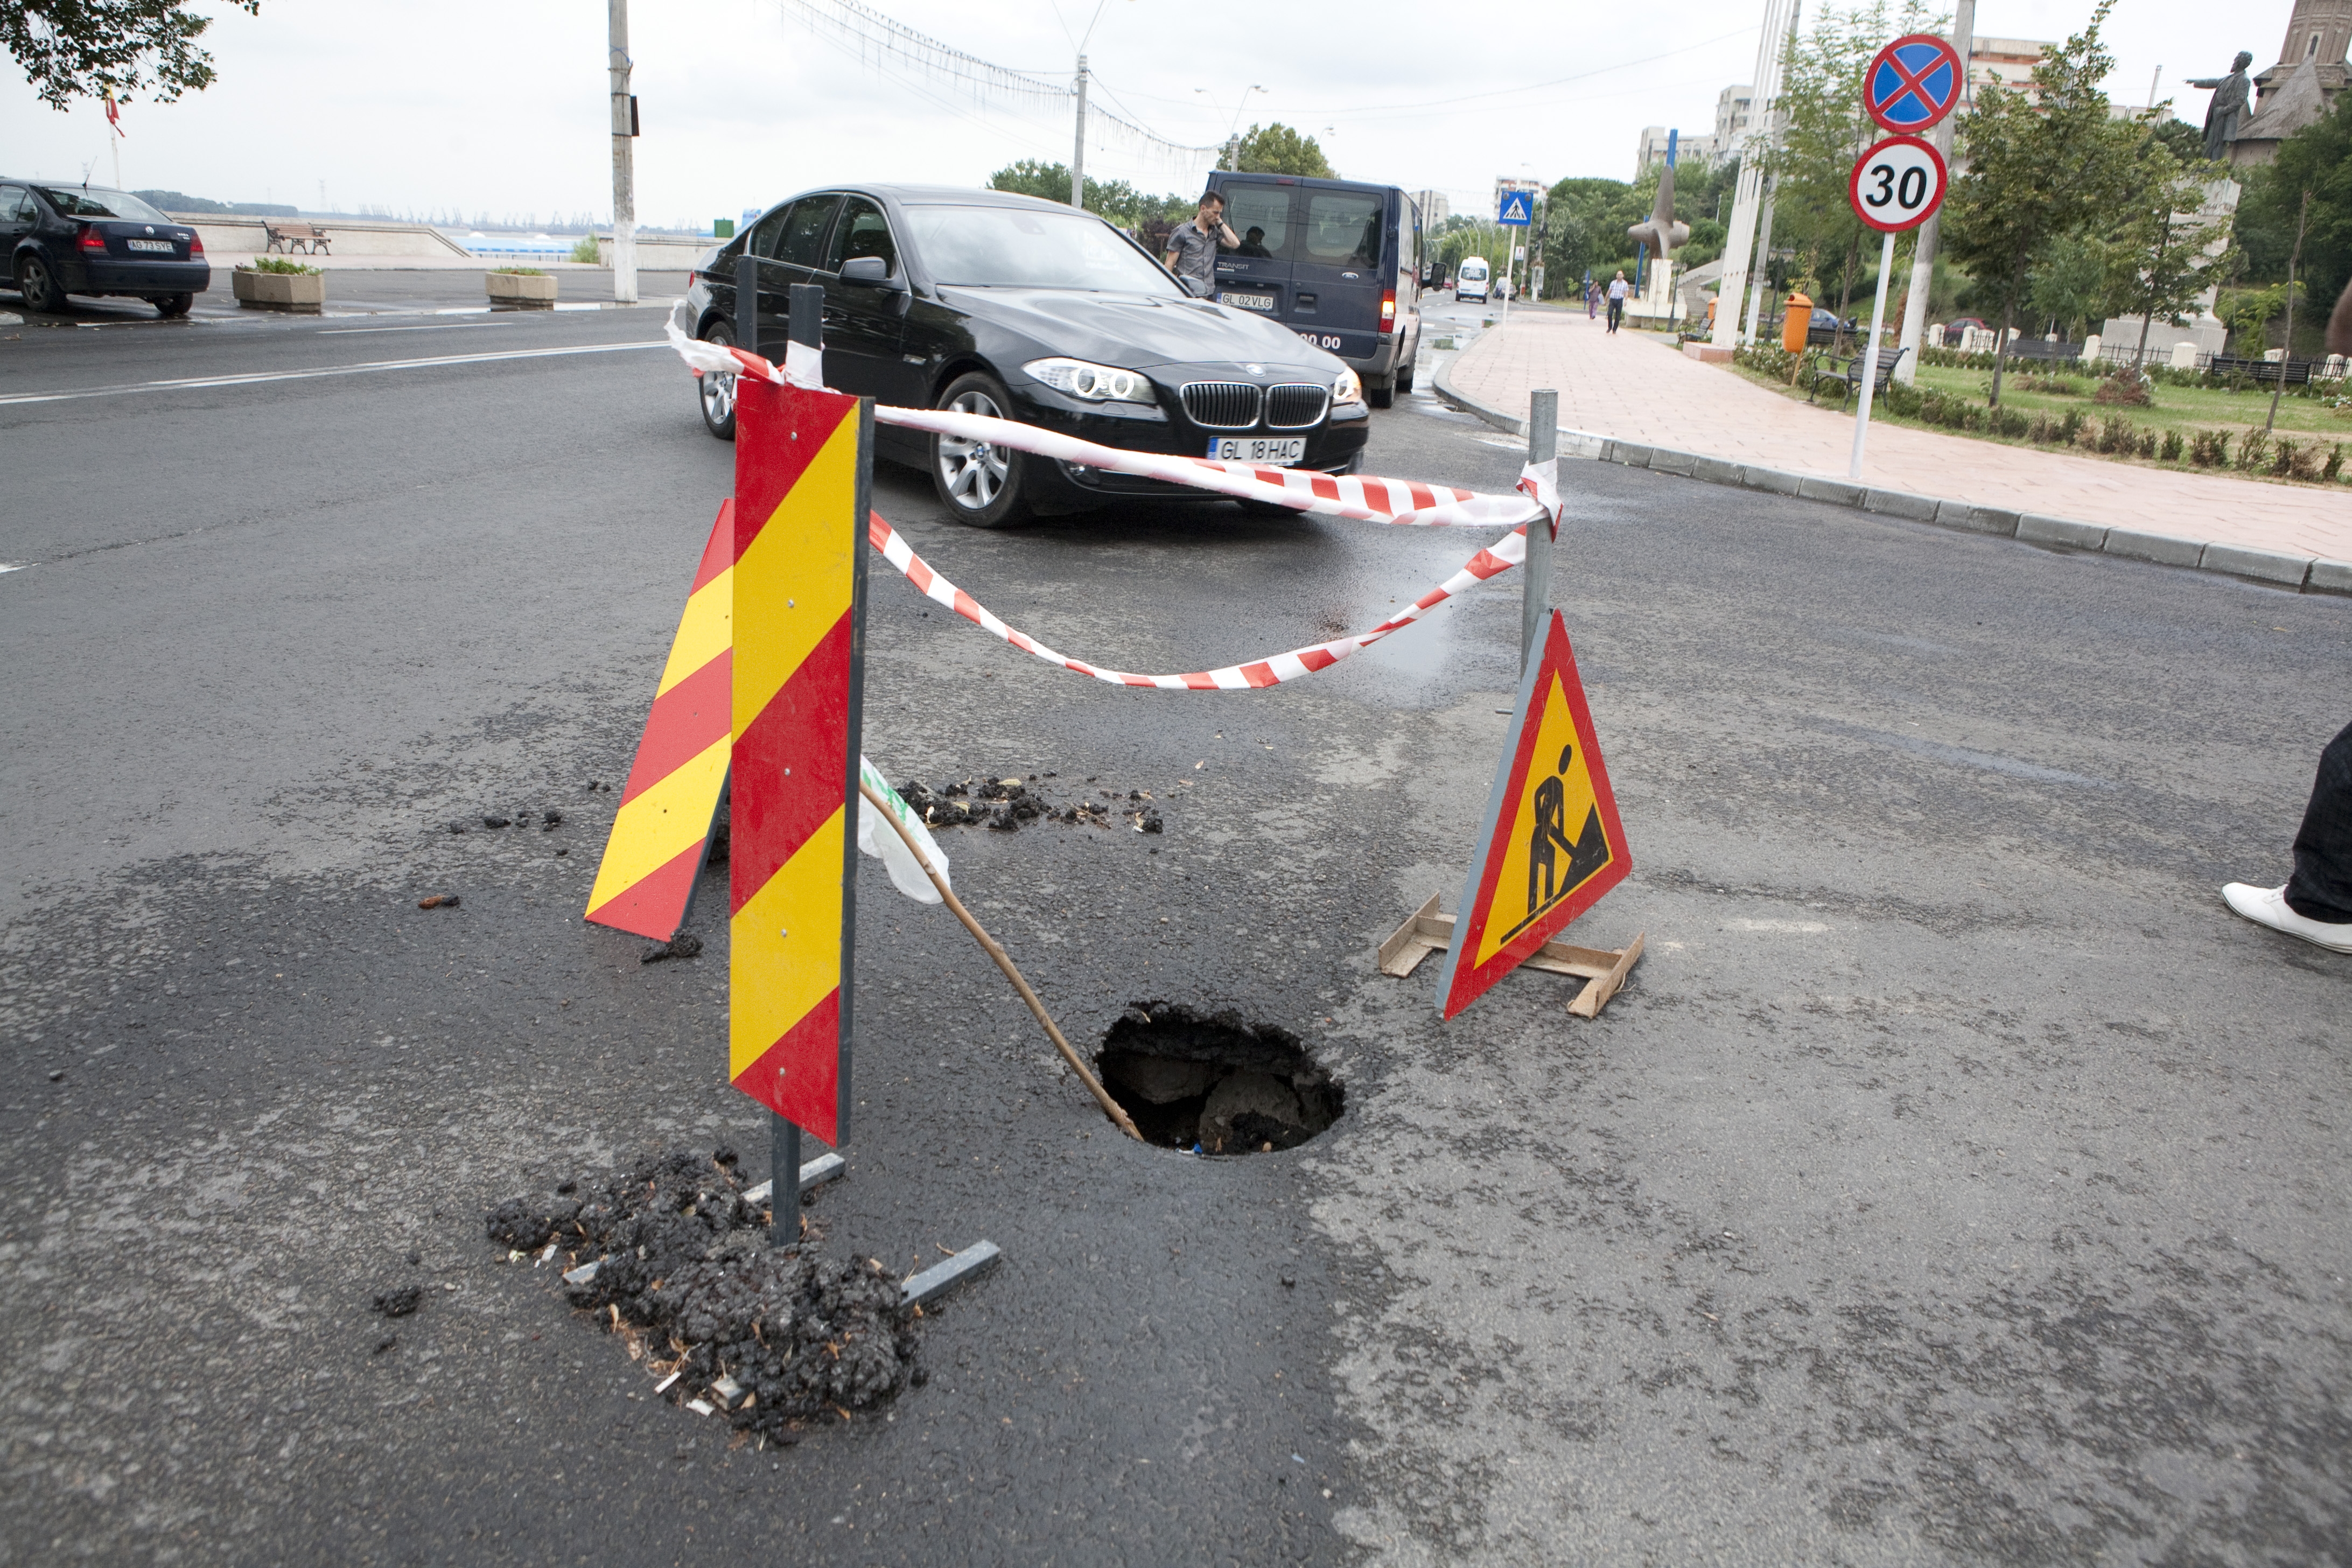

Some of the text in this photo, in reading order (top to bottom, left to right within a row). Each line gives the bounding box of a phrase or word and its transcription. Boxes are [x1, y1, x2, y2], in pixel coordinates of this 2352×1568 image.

[1866, 164, 1927, 209] 30
[132, 240, 171, 250] AG 73 SYE
[1217, 262, 1249, 270] TRANSIT
[1223, 294, 1235, 304] GL
[1239, 296, 1251, 305] 02
[1252, 297, 1271, 307] VLG
[1322, 336, 1340, 349] 00
[1221, 440, 1300, 459] GL 18 HAC
